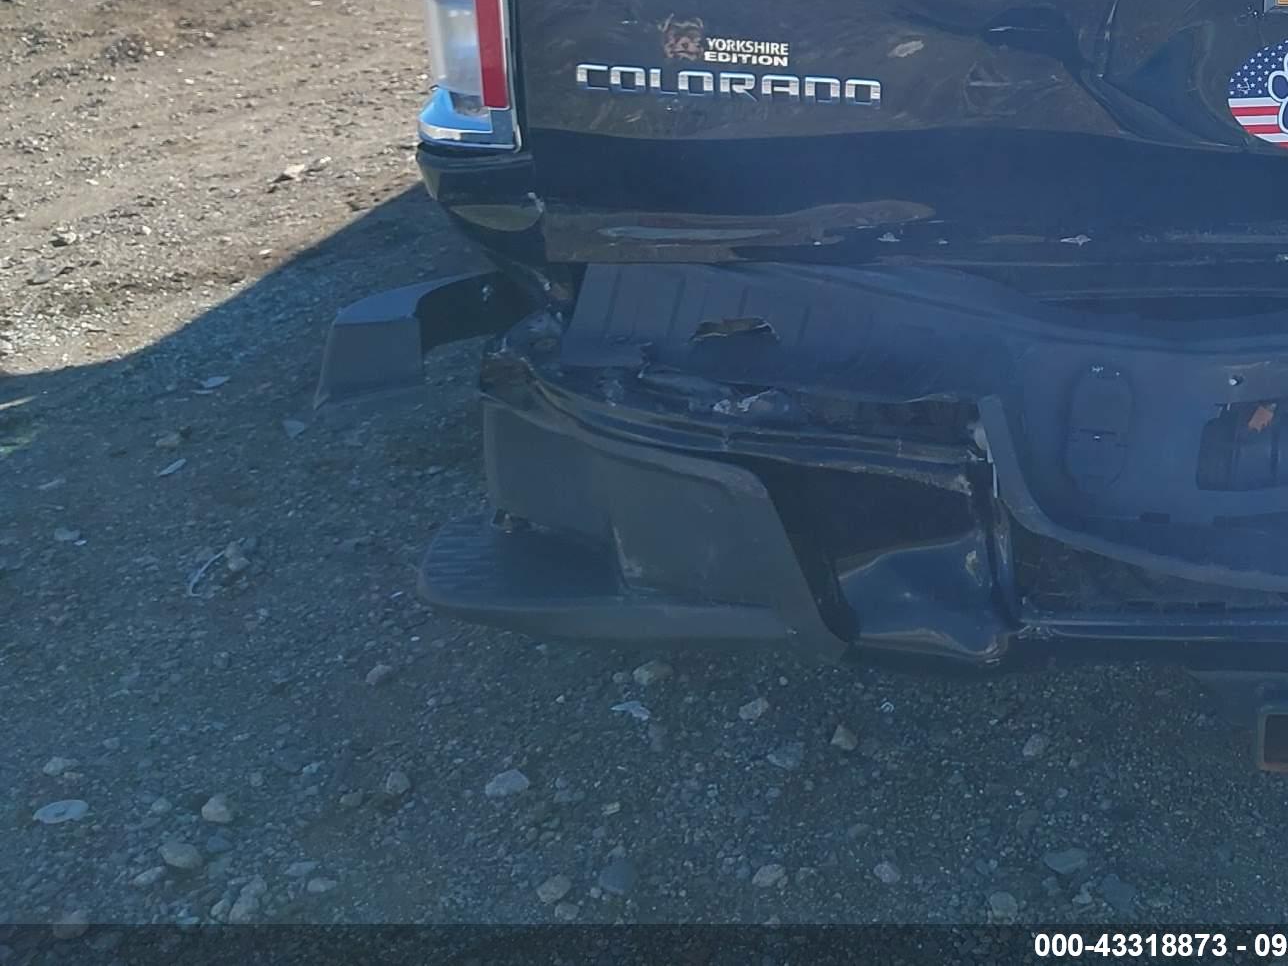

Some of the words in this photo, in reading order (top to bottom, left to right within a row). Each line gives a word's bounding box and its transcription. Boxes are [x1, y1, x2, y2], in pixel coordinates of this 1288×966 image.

[706, 37, 790, 56] YORKSHIRE
[704, 51, 790, 67] EDITION
[576, 63, 881, 106] COLORADO
